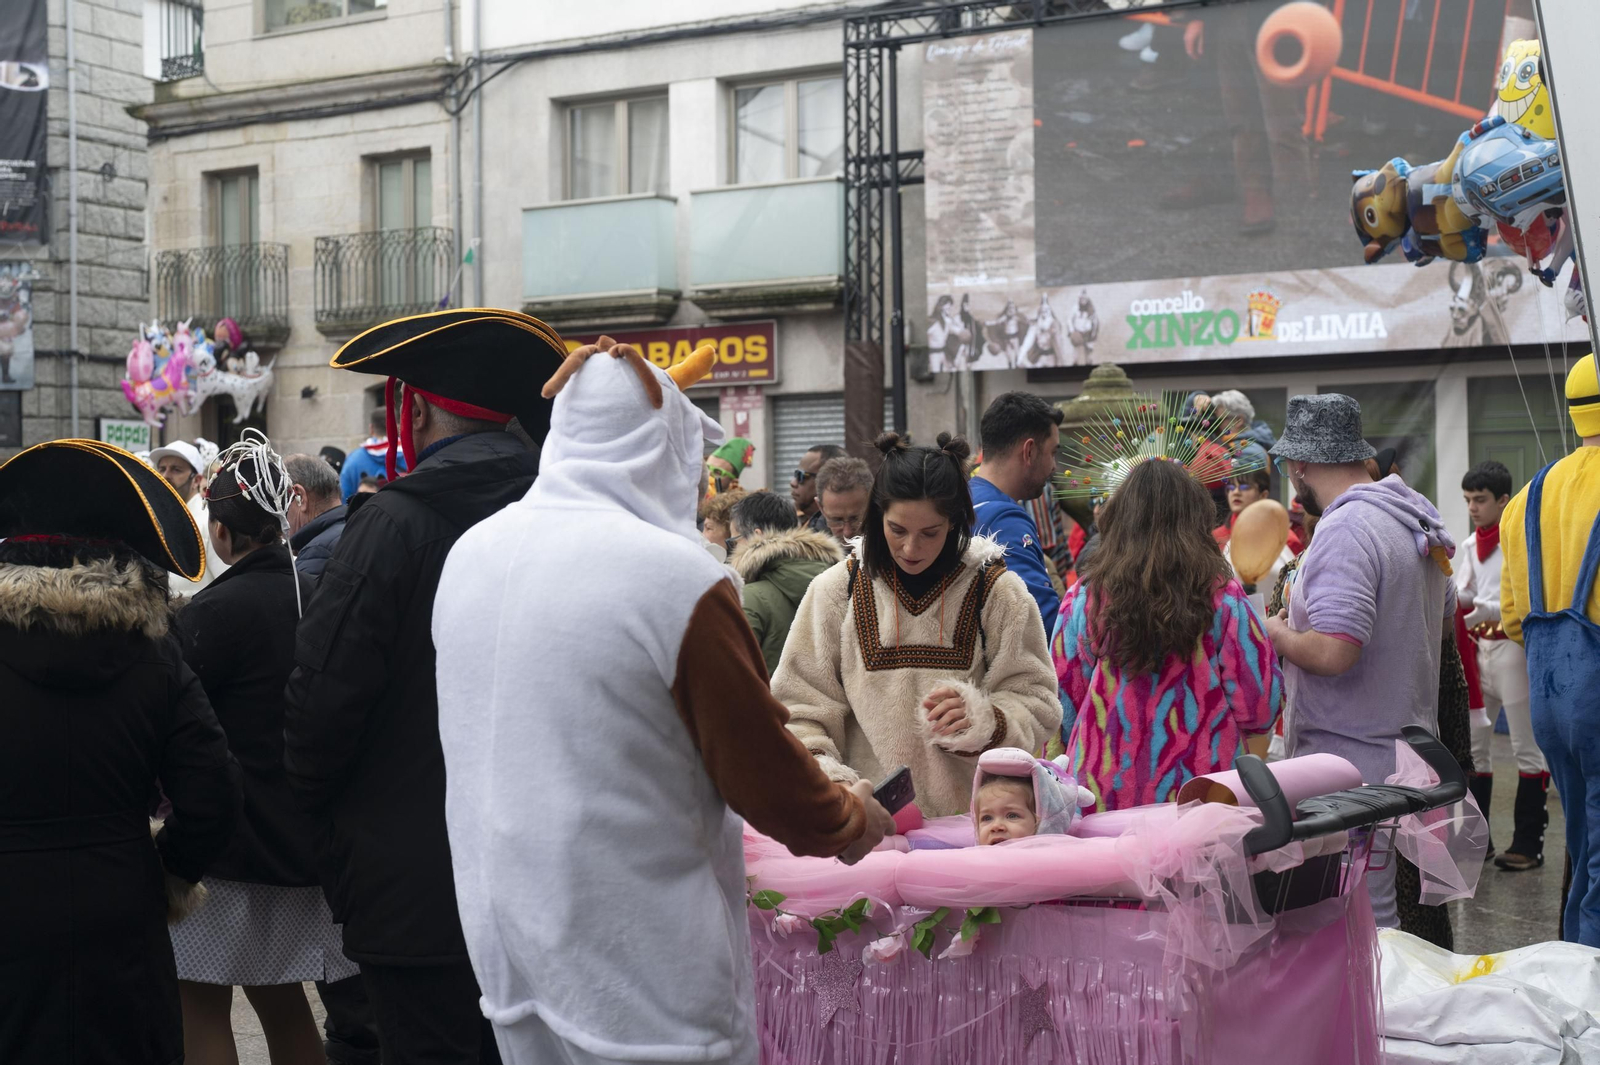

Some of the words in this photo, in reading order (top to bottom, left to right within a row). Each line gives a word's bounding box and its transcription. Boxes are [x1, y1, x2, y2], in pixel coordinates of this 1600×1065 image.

[1130, 290, 1205, 317] concello
[1126, 308, 1241, 350] XINZO
[1304, 311, 1388, 342] LIMIA
